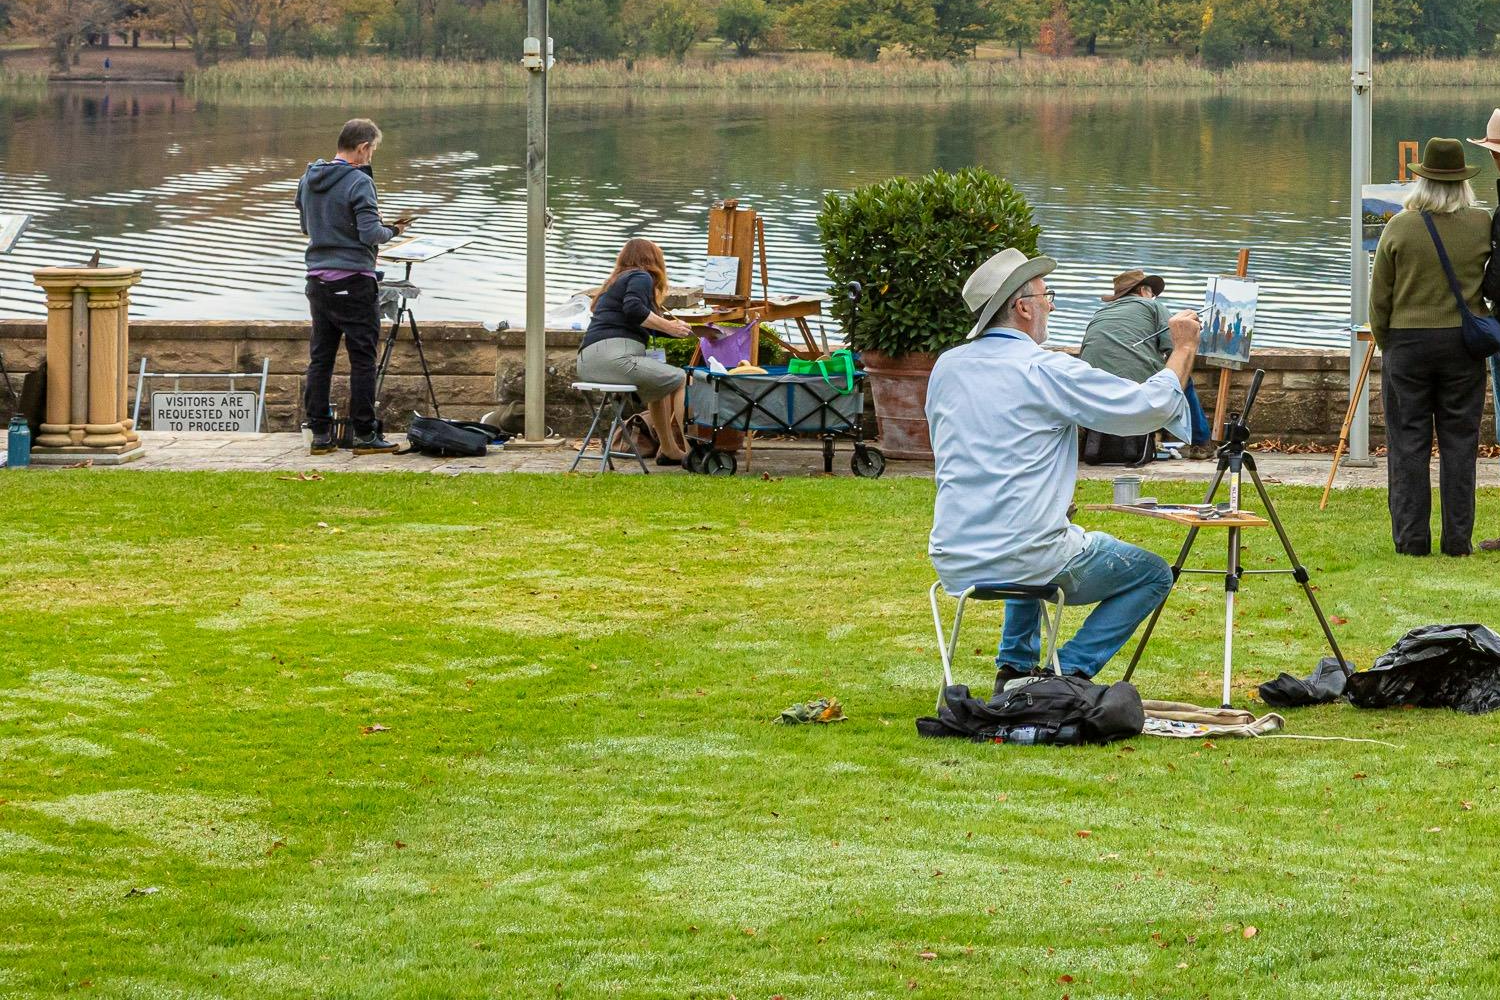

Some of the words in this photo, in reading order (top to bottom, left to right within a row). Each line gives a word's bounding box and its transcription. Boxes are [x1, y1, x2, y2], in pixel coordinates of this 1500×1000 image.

[166, 397, 215, 407] VISITORS
[221, 397, 243, 407] ARE
[159, 409, 223, 419] REQUESTED
[229, 409, 250, 419] NOT
[170, 421, 183, 431] TO
[188, 421, 240, 431] PROCEED
